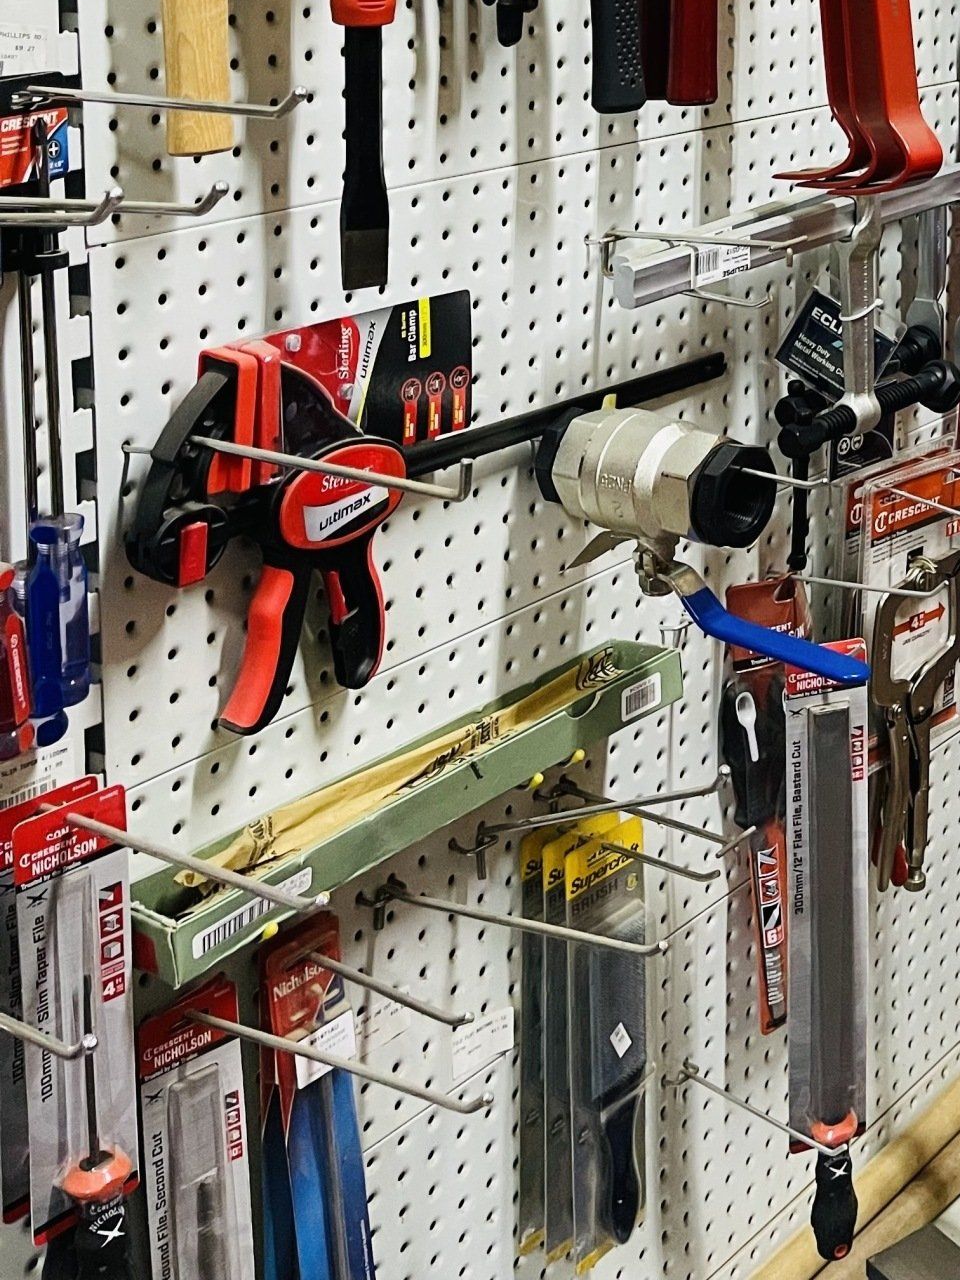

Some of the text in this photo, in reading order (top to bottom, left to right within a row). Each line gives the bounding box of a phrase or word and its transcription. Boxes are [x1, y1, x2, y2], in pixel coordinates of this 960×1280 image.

[721, 263, 749, 278] ECLIPSE
[407, 309, 418, 362] Bar Clamp
[811, 306, 844, 336] ECLI
[338, 323, 353, 380] Sterling
[794, 339, 811, 356] Metal
[811, 350, 836, 373] Working
[816, 343, 831, 359] Duty
[11, 646, 26, 703] CRESCENT
[796, 676, 840, 692] NICHOLS
[791, 740, 801, 758] Cut
[792, 760, 802, 803] Bastard
[794, 829, 803, 849] Flat
[31, 837, 98, 877] NICHOLSON
[20, 874, 43, 892] Trusted
[571, 878, 619, 917] BRUSH
[6, 905, 17, 932] File
[33, 915, 50, 1025] Slim Taper File
[153, 1029, 195, 1054] CRESCENT
[153, 1030, 212, 1069] NICHOLSON
[151, 1130, 163, 1158] Cut
[155, 1160, 168, 1208] Second
[157, 1207, 169, 1238] File,
